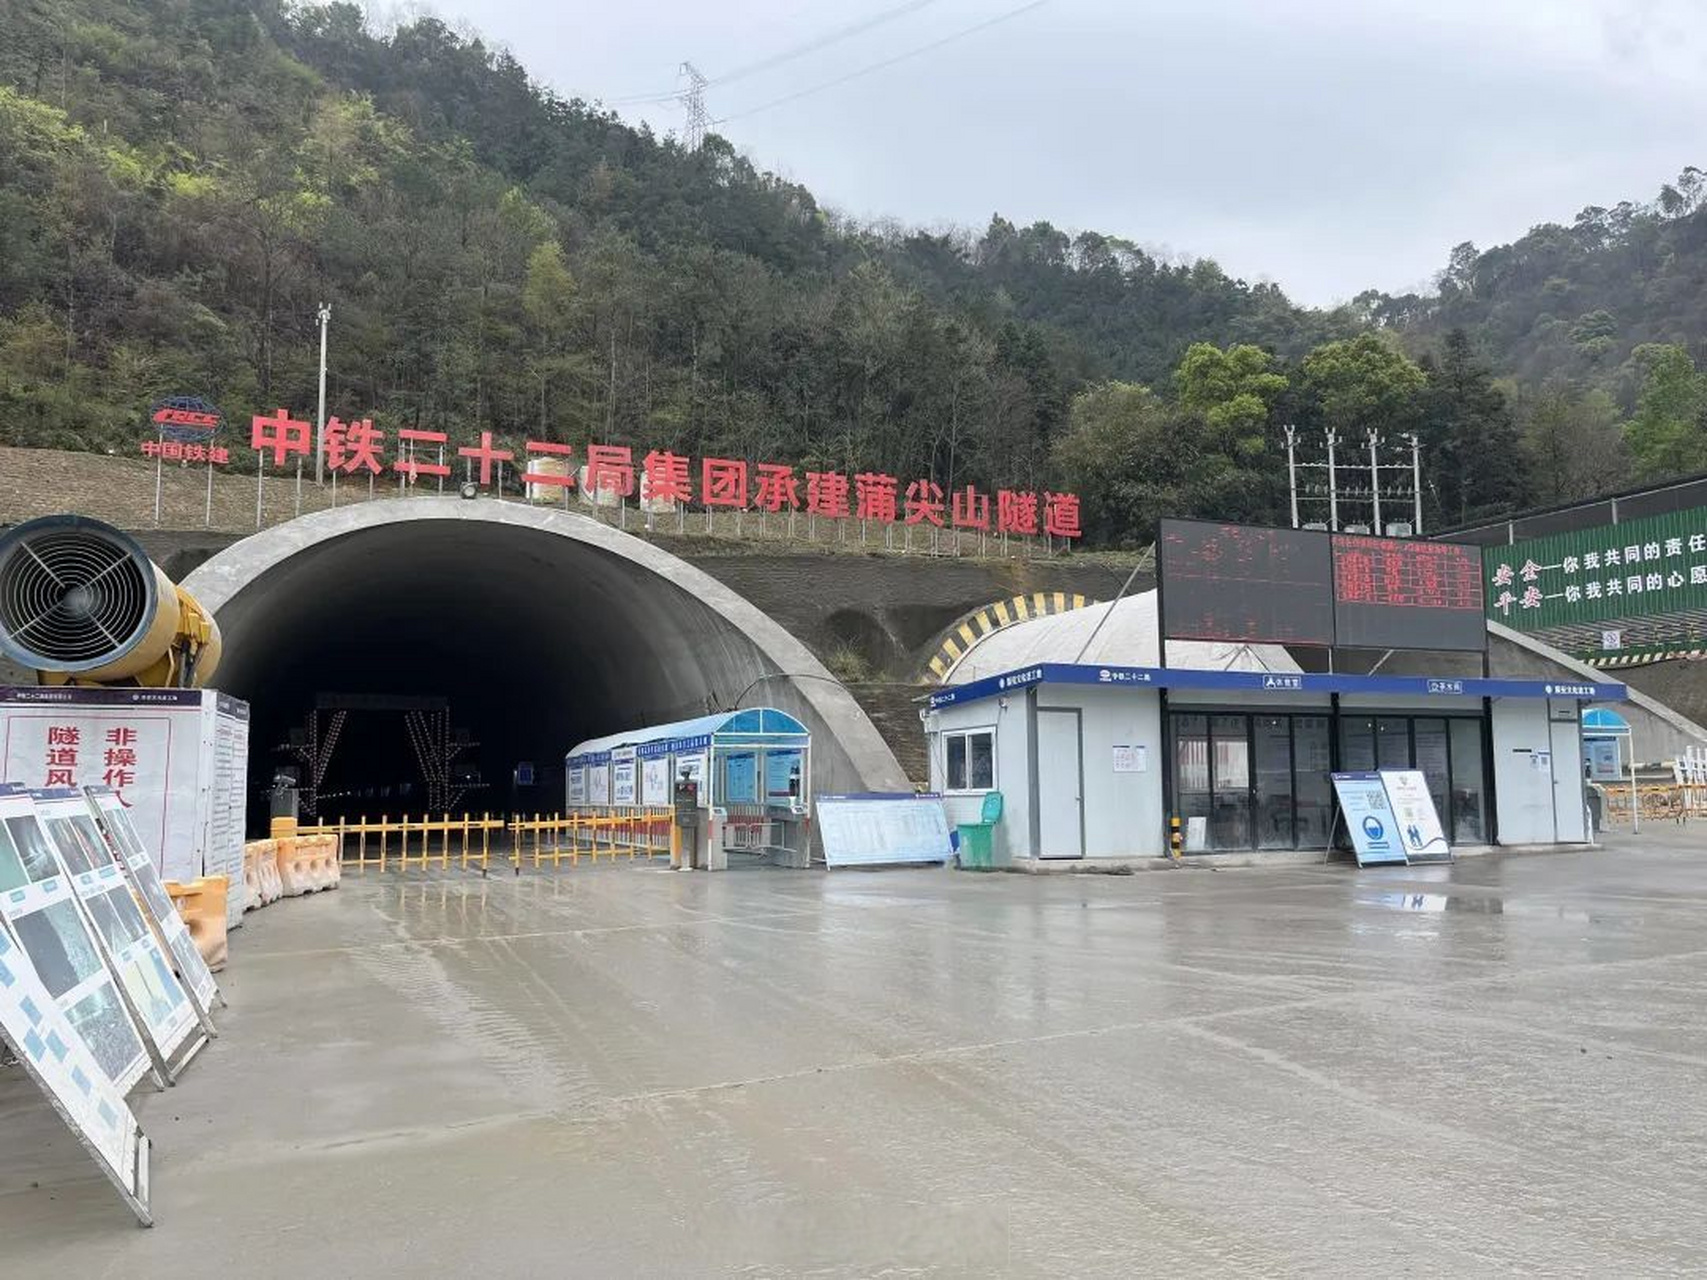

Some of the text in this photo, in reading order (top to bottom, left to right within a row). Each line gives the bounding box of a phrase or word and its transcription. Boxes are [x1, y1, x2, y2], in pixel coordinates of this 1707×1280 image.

[141, 440, 229, 464] 中国铁建
[251, 408, 1082, 538] 中铁二十二局集团承建蒲尖山隧道
[45, 726, 81, 787] 隧道风
